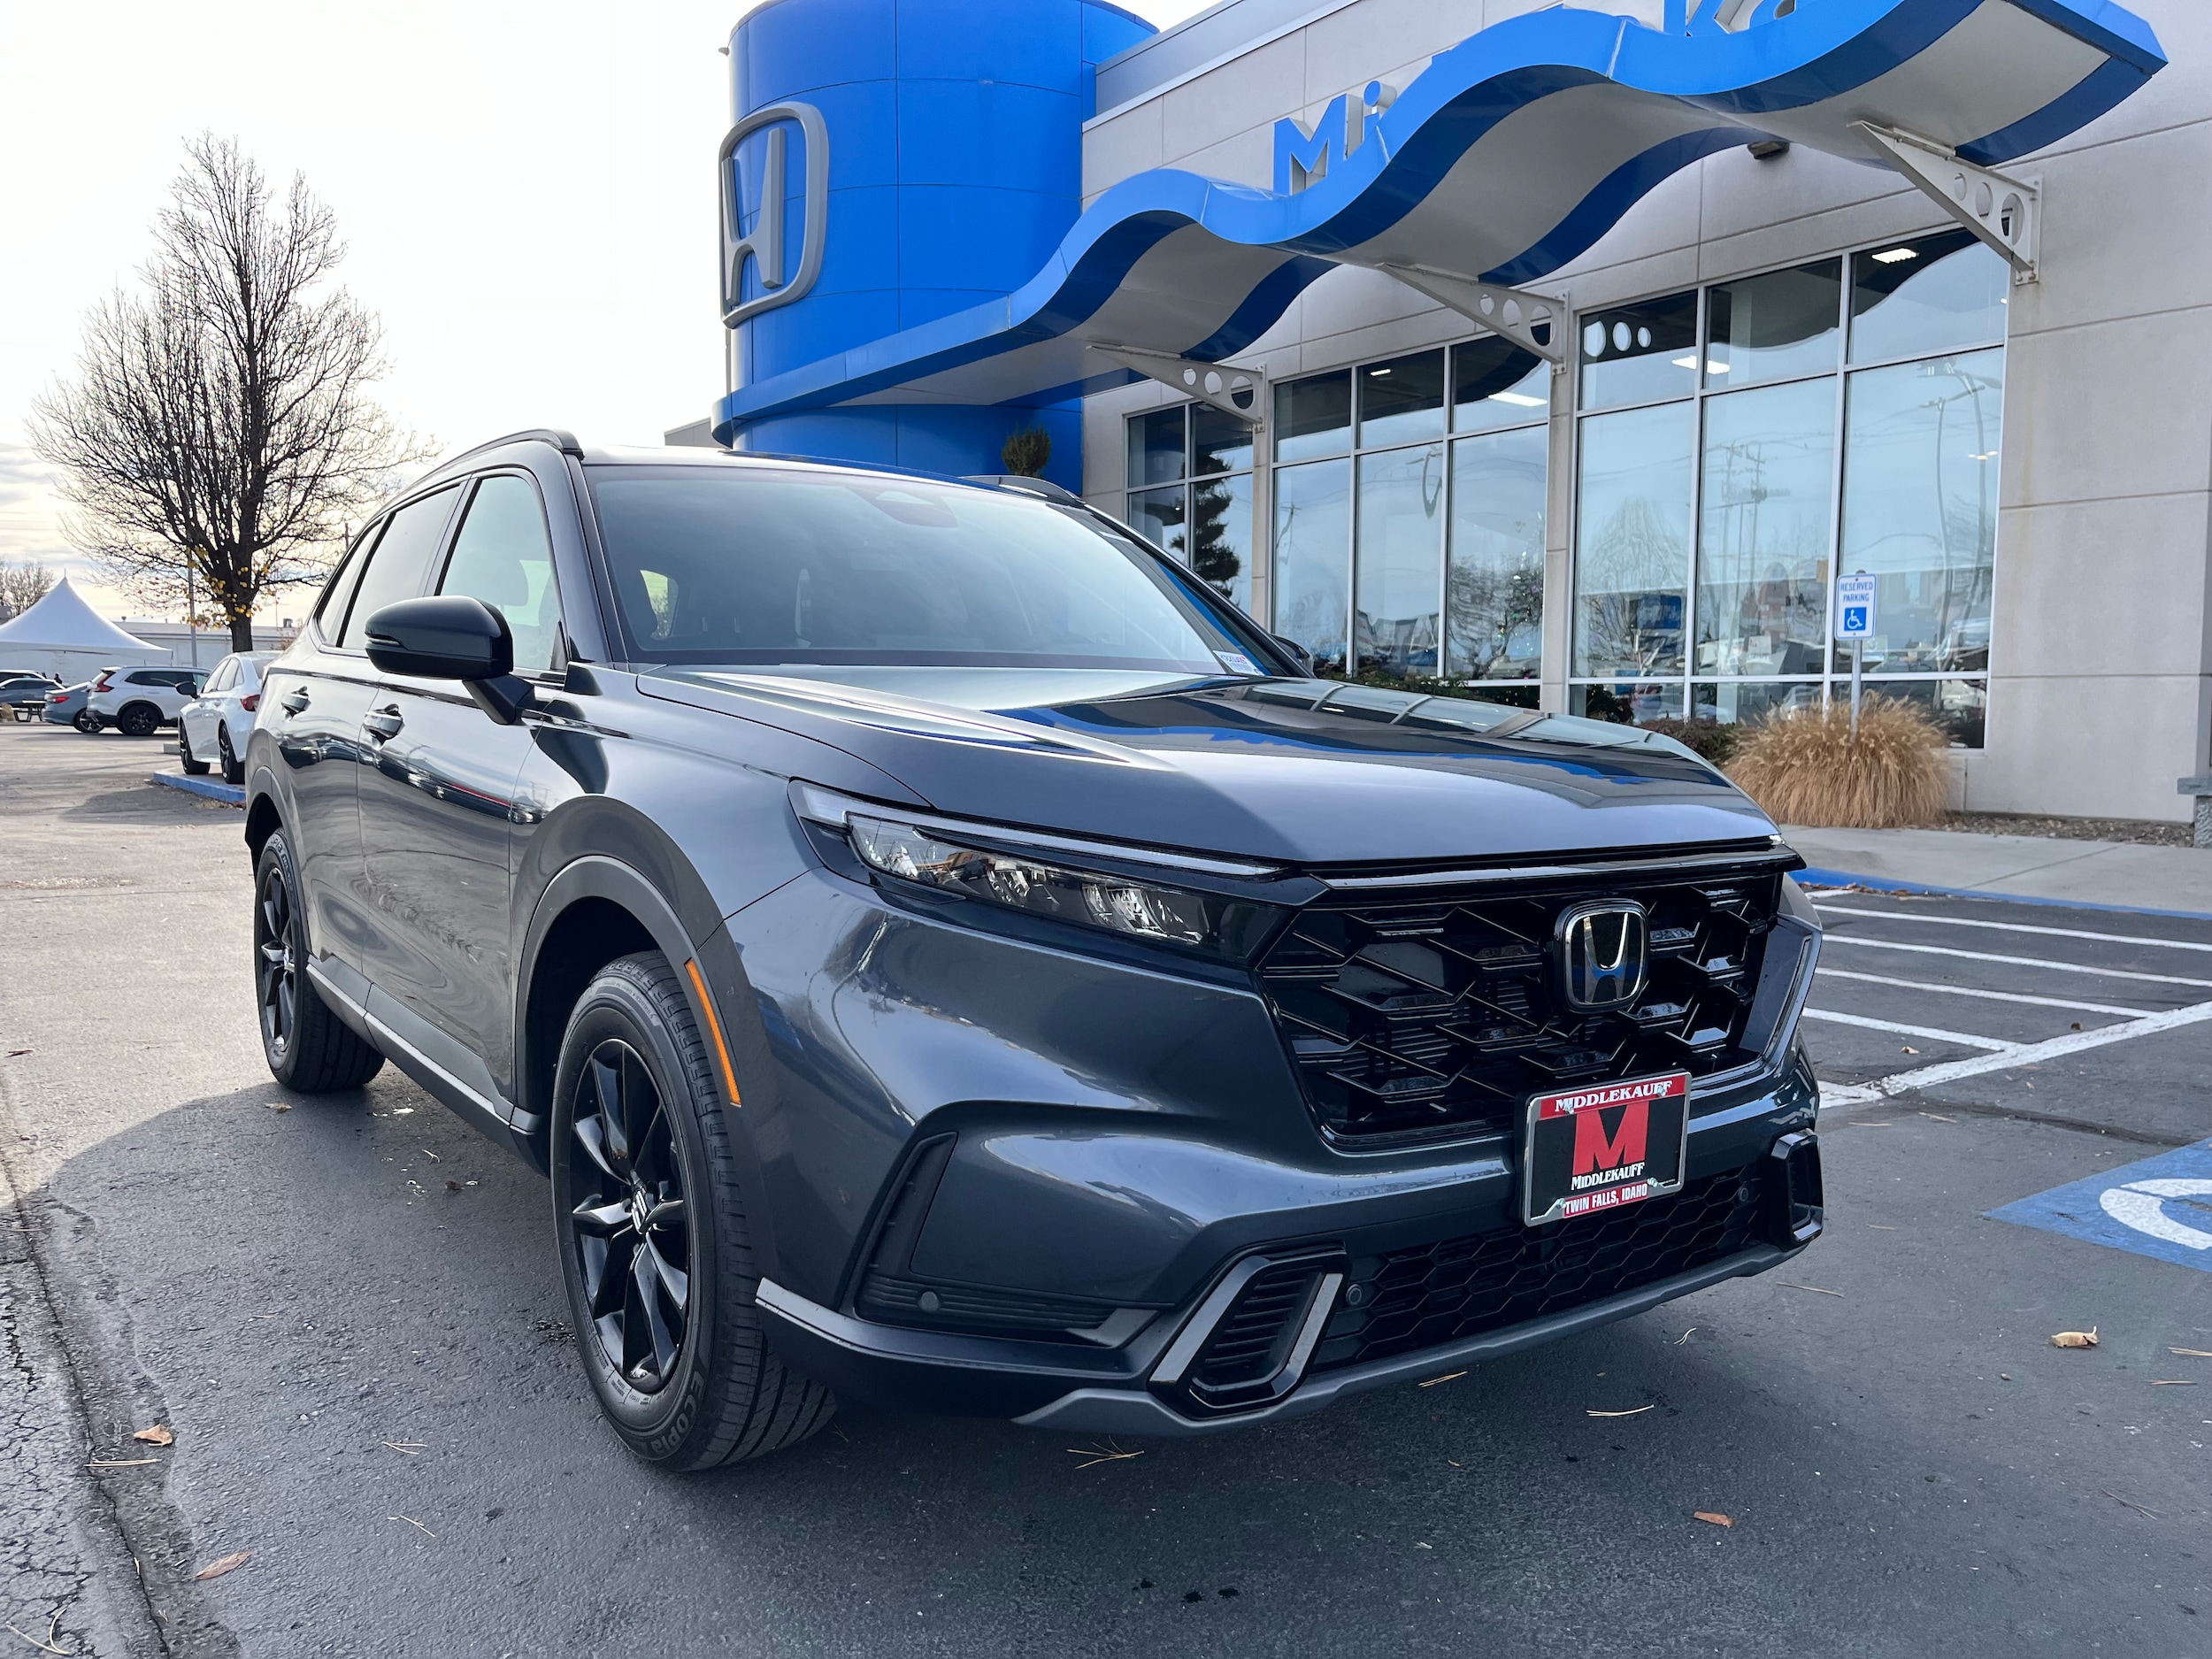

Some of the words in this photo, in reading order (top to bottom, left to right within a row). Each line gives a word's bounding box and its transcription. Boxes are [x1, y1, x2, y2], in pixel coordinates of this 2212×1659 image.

[1840, 581, 1874, 592] RESERVED
[1843, 593, 1870, 603] PARKING
[1555, 1079, 1673, 1112] MIDDLEKAUFF
[1572, 1101, 1650, 1176] M
[1571, 1162, 1645, 1191] MIDDLEKAUFF
[1565, 1196, 1590, 1215] TWIN
[1592, 1190, 1619, 1208] FALLS,
[1621, 1183, 1648, 1201] IDAHO
